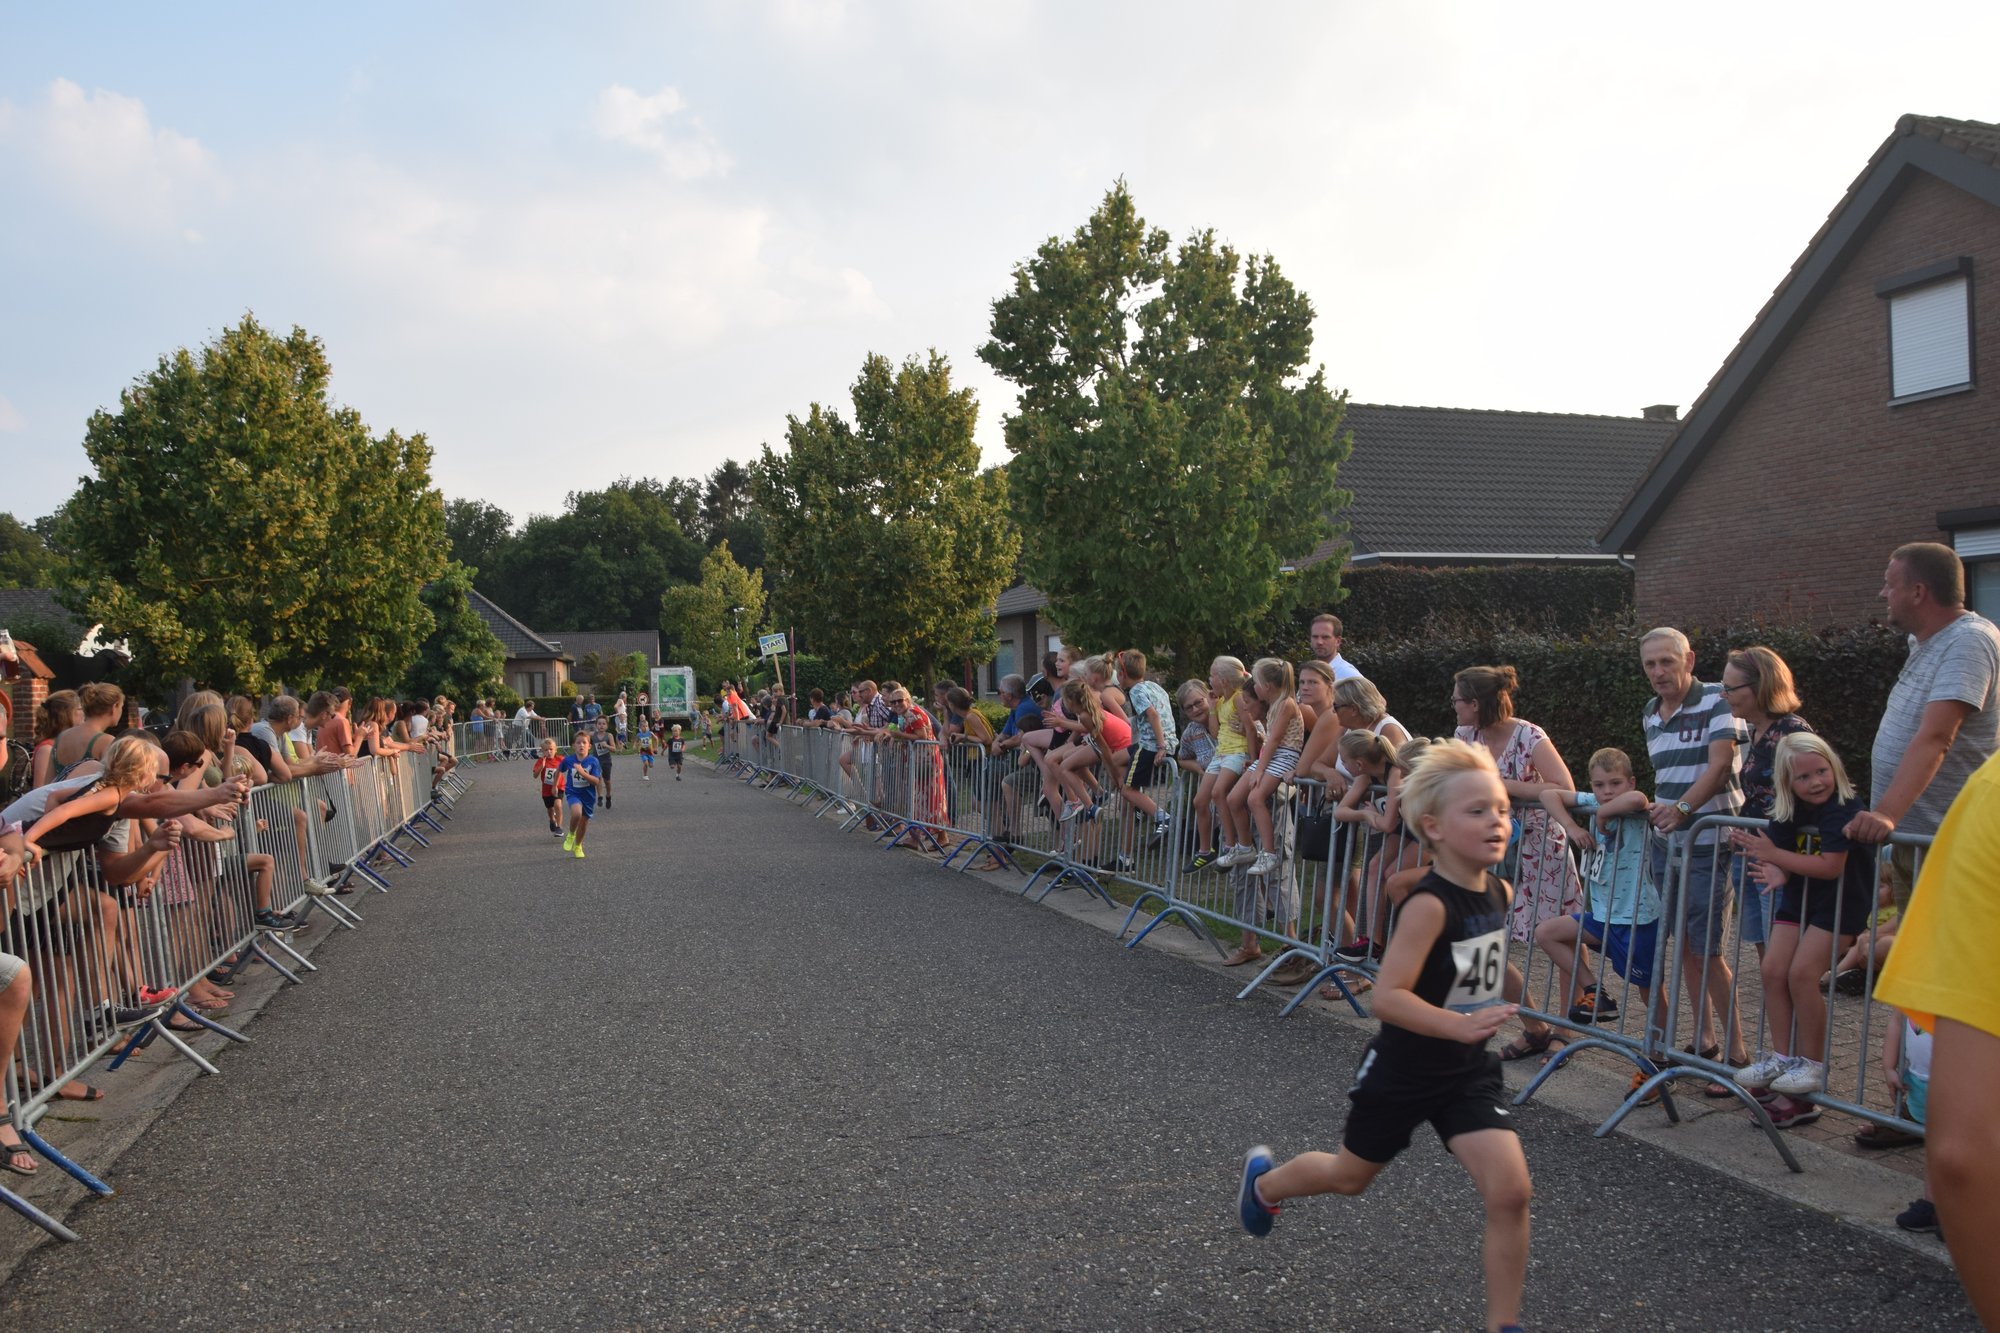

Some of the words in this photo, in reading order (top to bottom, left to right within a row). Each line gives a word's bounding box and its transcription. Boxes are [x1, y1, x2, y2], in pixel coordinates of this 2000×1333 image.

[762, 638, 785, 651] START
[1679, 711, 1708, 742] 67
[1457, 942, 1500, 995] 46
